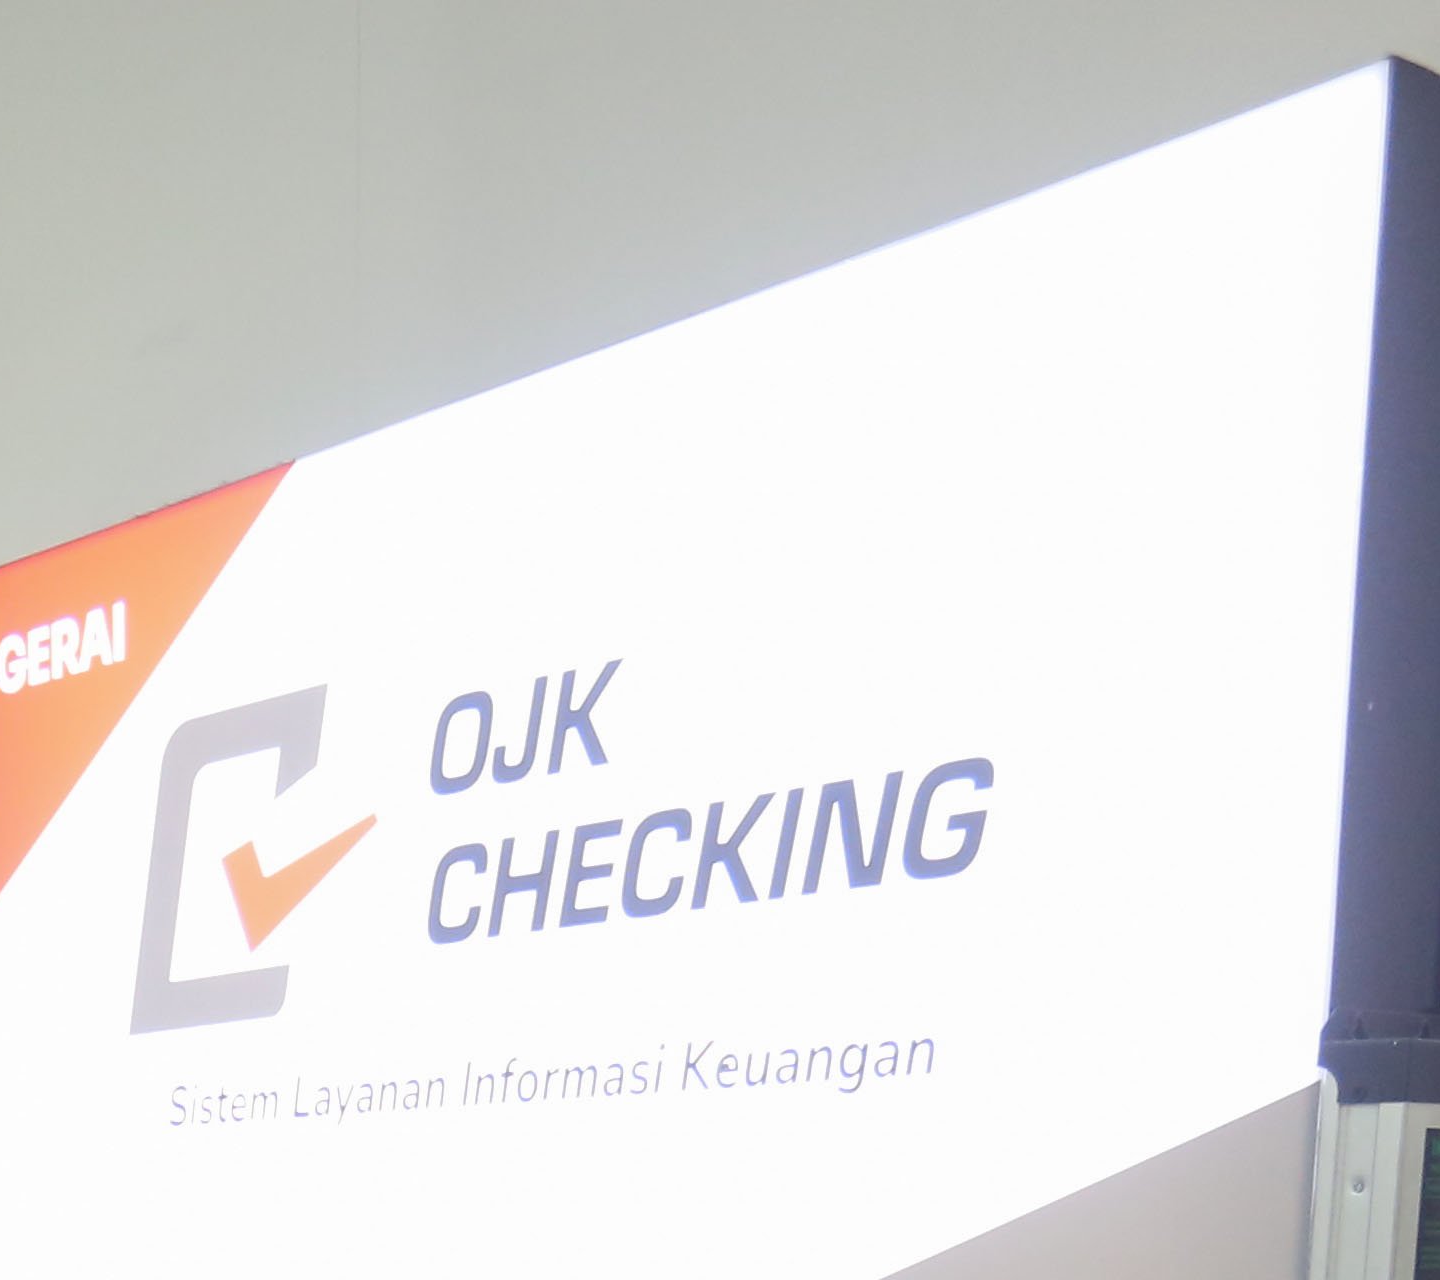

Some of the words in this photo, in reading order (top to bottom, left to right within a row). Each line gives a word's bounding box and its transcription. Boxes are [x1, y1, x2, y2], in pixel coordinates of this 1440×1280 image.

[429, 658, 623, 795] OJK
[428, 757, 994, 944] CHECKING
[169, 1084, 279, 1127] Sistem
[292, 1073, 445, 1124] Layanan
[462, 1044, 666, 1107] Informasi
[680, 1037, 937, 1095] Keuangan
